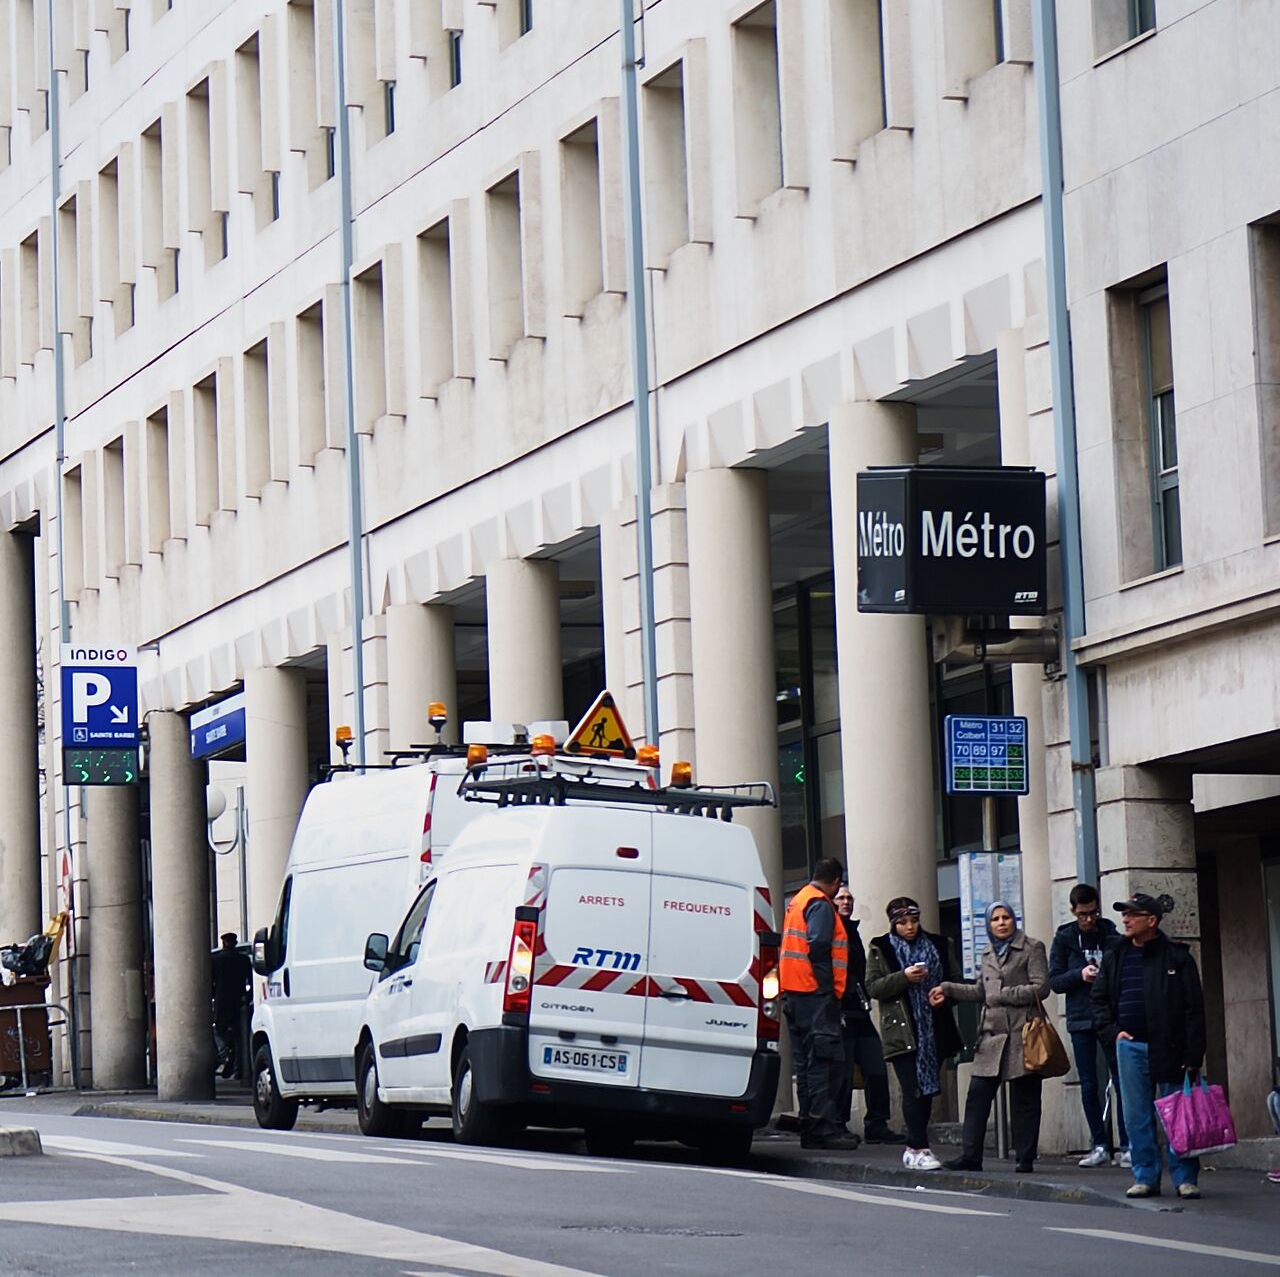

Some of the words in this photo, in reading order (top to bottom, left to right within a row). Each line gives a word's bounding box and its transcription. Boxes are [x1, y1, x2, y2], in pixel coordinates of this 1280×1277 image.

[859, 510, 905, 557] Métro
[921, 510, 1036, 559] Métro
[70, 649, 128, 661] INDIGO
[72, 672, 112, 723] P
[991, 723, 1004, 732] 31
[1008, 723, 1022, 733] 32
[956, 745, 970, 756] 70
[973, 745, 987, 756] 89
[991, 746, 1005, 756] 97
[578, 894, 625, 907] ARRETS
[663, 900, 732, 916] FREQUENTS
[571, 947, 641, 971] RTM
[705, 1019, 749, 1029] JUMPY
[553, 1050, 617, 1070] AS-061-CS
